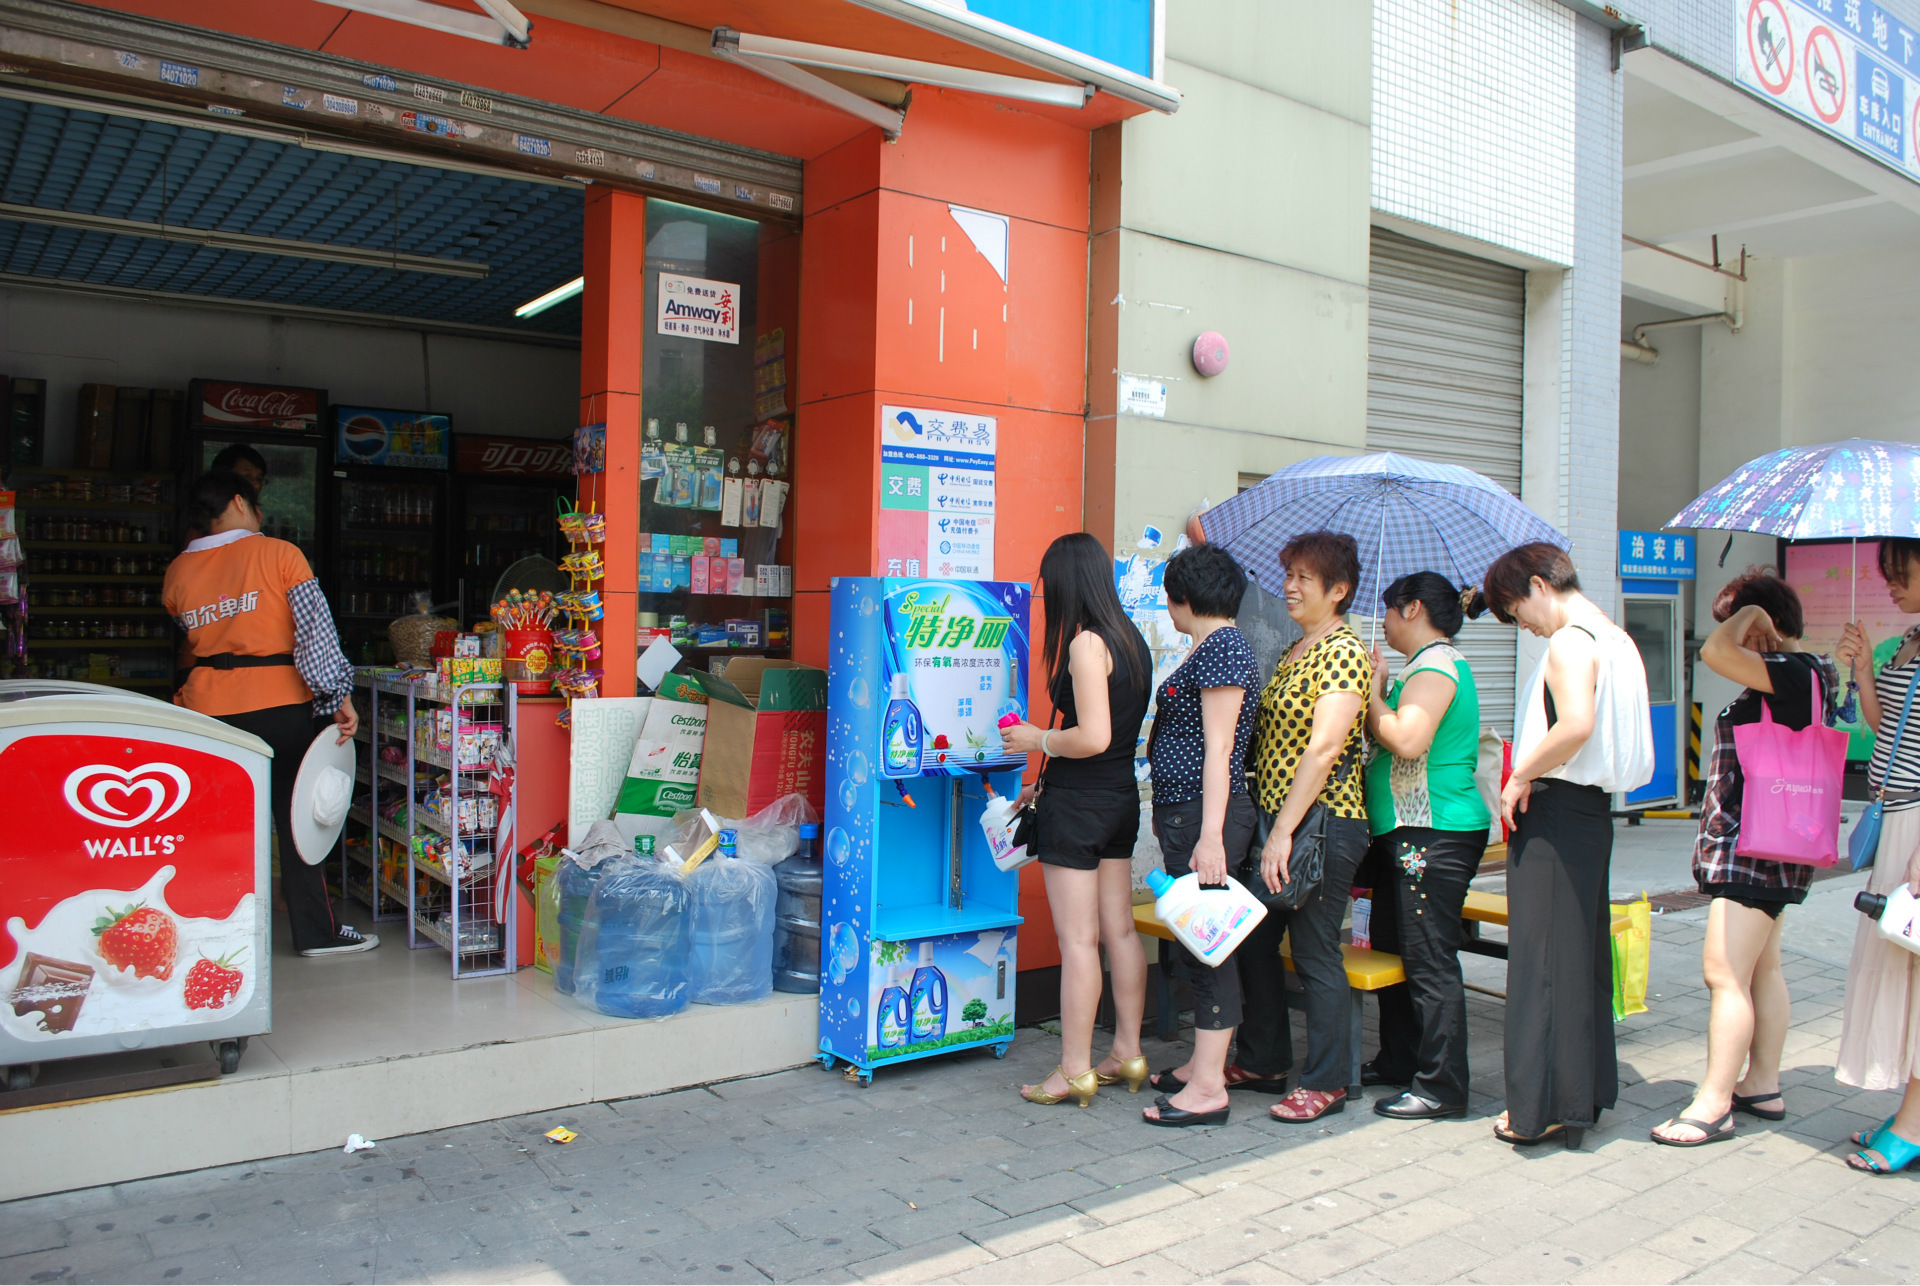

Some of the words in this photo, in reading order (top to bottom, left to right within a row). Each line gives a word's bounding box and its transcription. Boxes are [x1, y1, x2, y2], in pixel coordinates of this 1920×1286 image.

[161, 68, 197, 86] 84071020
[1862, 121, 1899, 154] ENTRANCE
[686, 286, 716, 299] 免费送货
[665, 298, 721, 323] Amway
[714, 289, 734, 331] 安利
[221, 387, 300, 416] Coca-Cola
[927, 418, 990, 440] 交费易
[481, 442, 573, 475] 可口可乐
[888, 475, 922, 496] 交费
[953, 518, 976, 526] 中国电信
[1631, 535, 1686, 562] 治安岗
[759, 567, 768, 576] 502
[769, 566, 779, 576] 502
[782, 567, 791, 576] 502
[887, 558, 921, 578] 充值
[954, 565, 979, 574] 中国联通
[898, 591, 951, 617] Special
[904, 615, 1013, 650] 特净丽
[914, 655, 1001, 669] 环保有氧高浓度洗衣液
[576, 707, 605, 826] 联通极速
[84, 835, 176, 860] WALL'S
